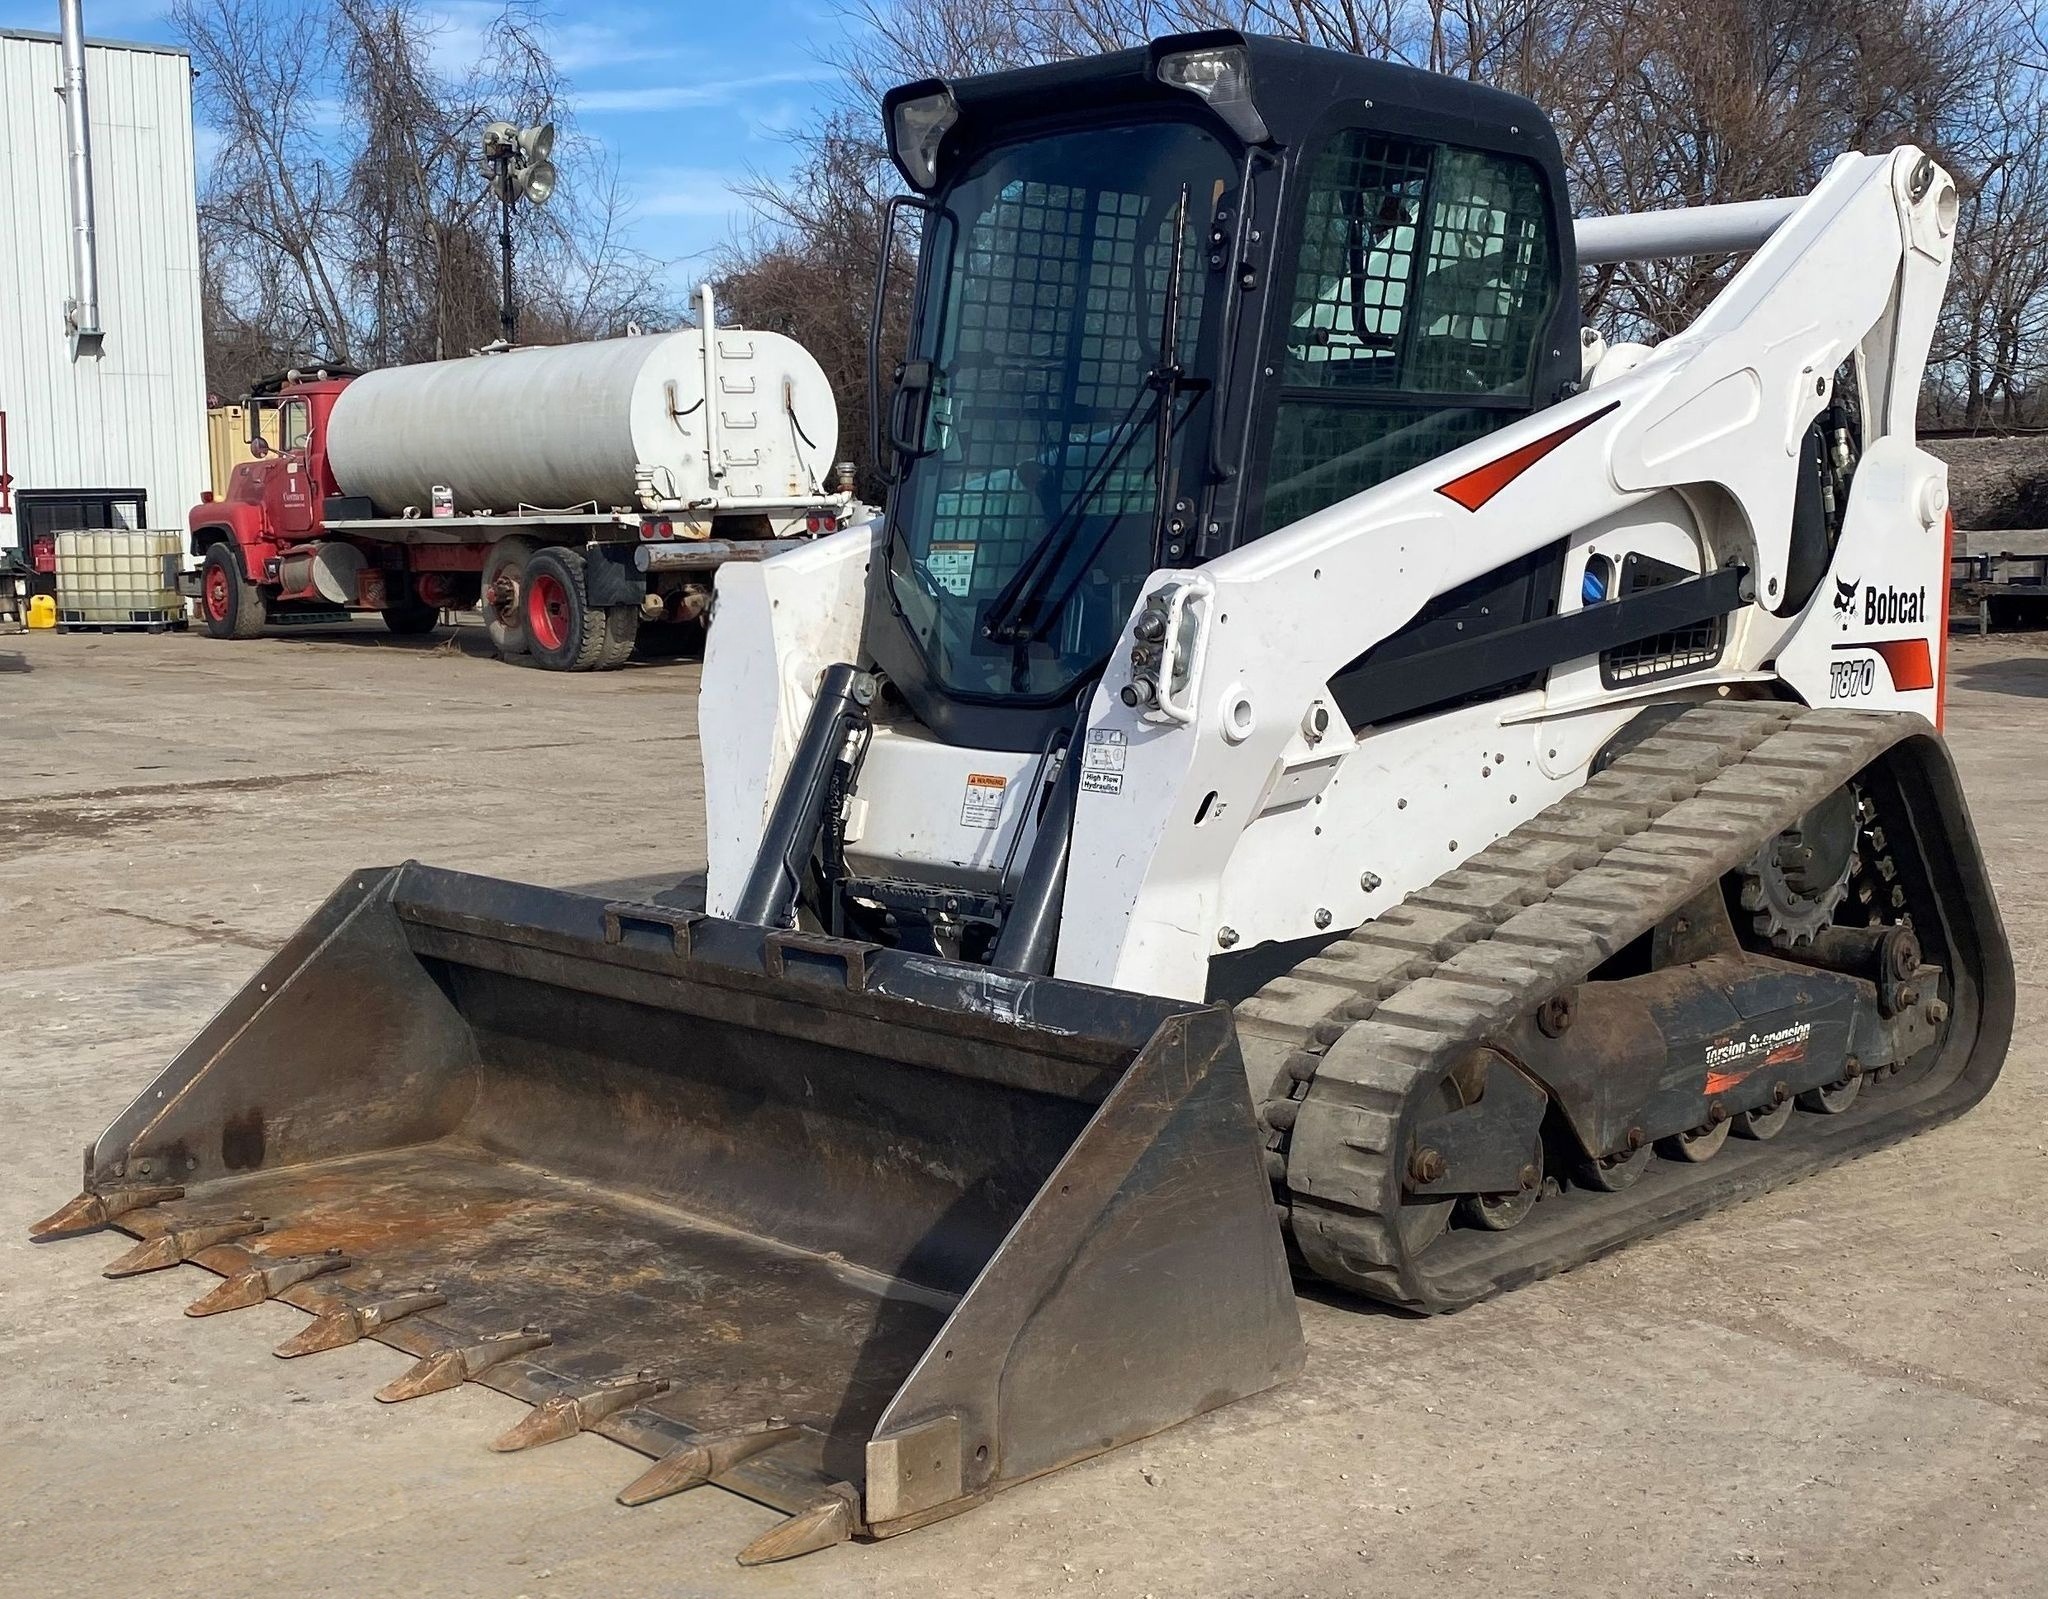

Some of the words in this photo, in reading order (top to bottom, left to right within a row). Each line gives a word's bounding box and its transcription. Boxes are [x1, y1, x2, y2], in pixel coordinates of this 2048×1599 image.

[1864, 585, 1926, 626] Bobcat
[1830, 658, 1875, 700] T870
[976, 777, 1004, 786] WARNING
[1084, 781, 1119, 792] Hydraulics
[1086, 773, 1101, 782] High
[1103, 775, 1119, 783] Flow
[1705, 1040, 1747, 1067] Torsion
[1747, 1021, 1811, 1056] Suspension
